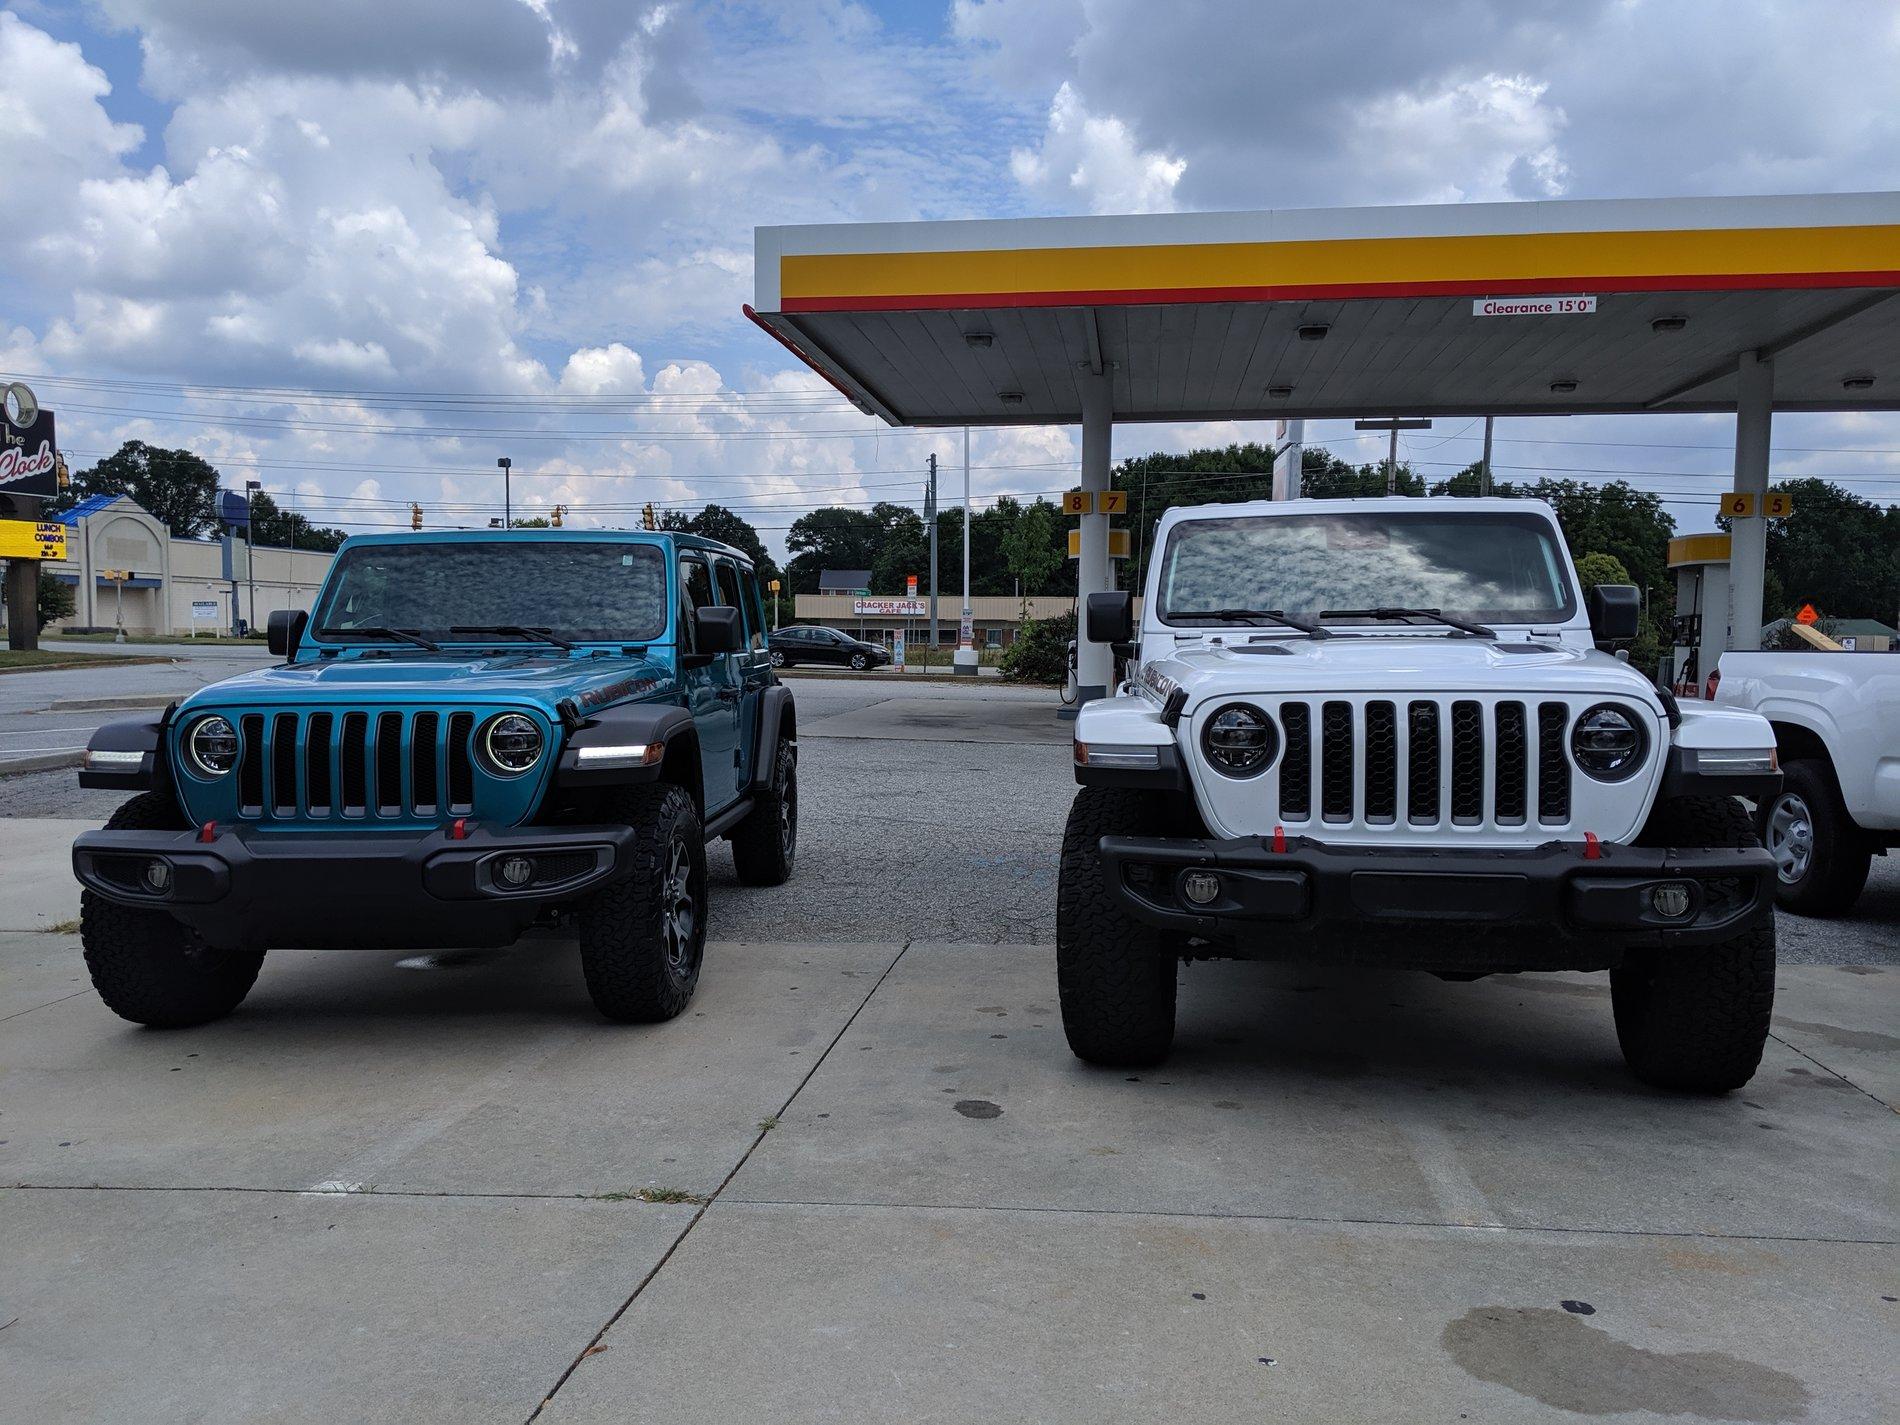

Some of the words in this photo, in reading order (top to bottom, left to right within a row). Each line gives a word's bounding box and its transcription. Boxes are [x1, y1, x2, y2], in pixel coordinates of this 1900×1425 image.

[1483, 302, 1553, 314] Clearance
[0, 442, 54, 481] Clock
[1072, 496, 1082, 510] 8
[1107, 496, 1119, 510] 7
[1733, 498, 1746, 513] 6
[1772, 498, 1783, 513] 5
[36, 523, 61, 533] LUNCH
[34, 533, 65, 543] COMBOS
[855, 601, 895, 609] CRACKER
[1143, 666, 1179, 697] RUBICON
